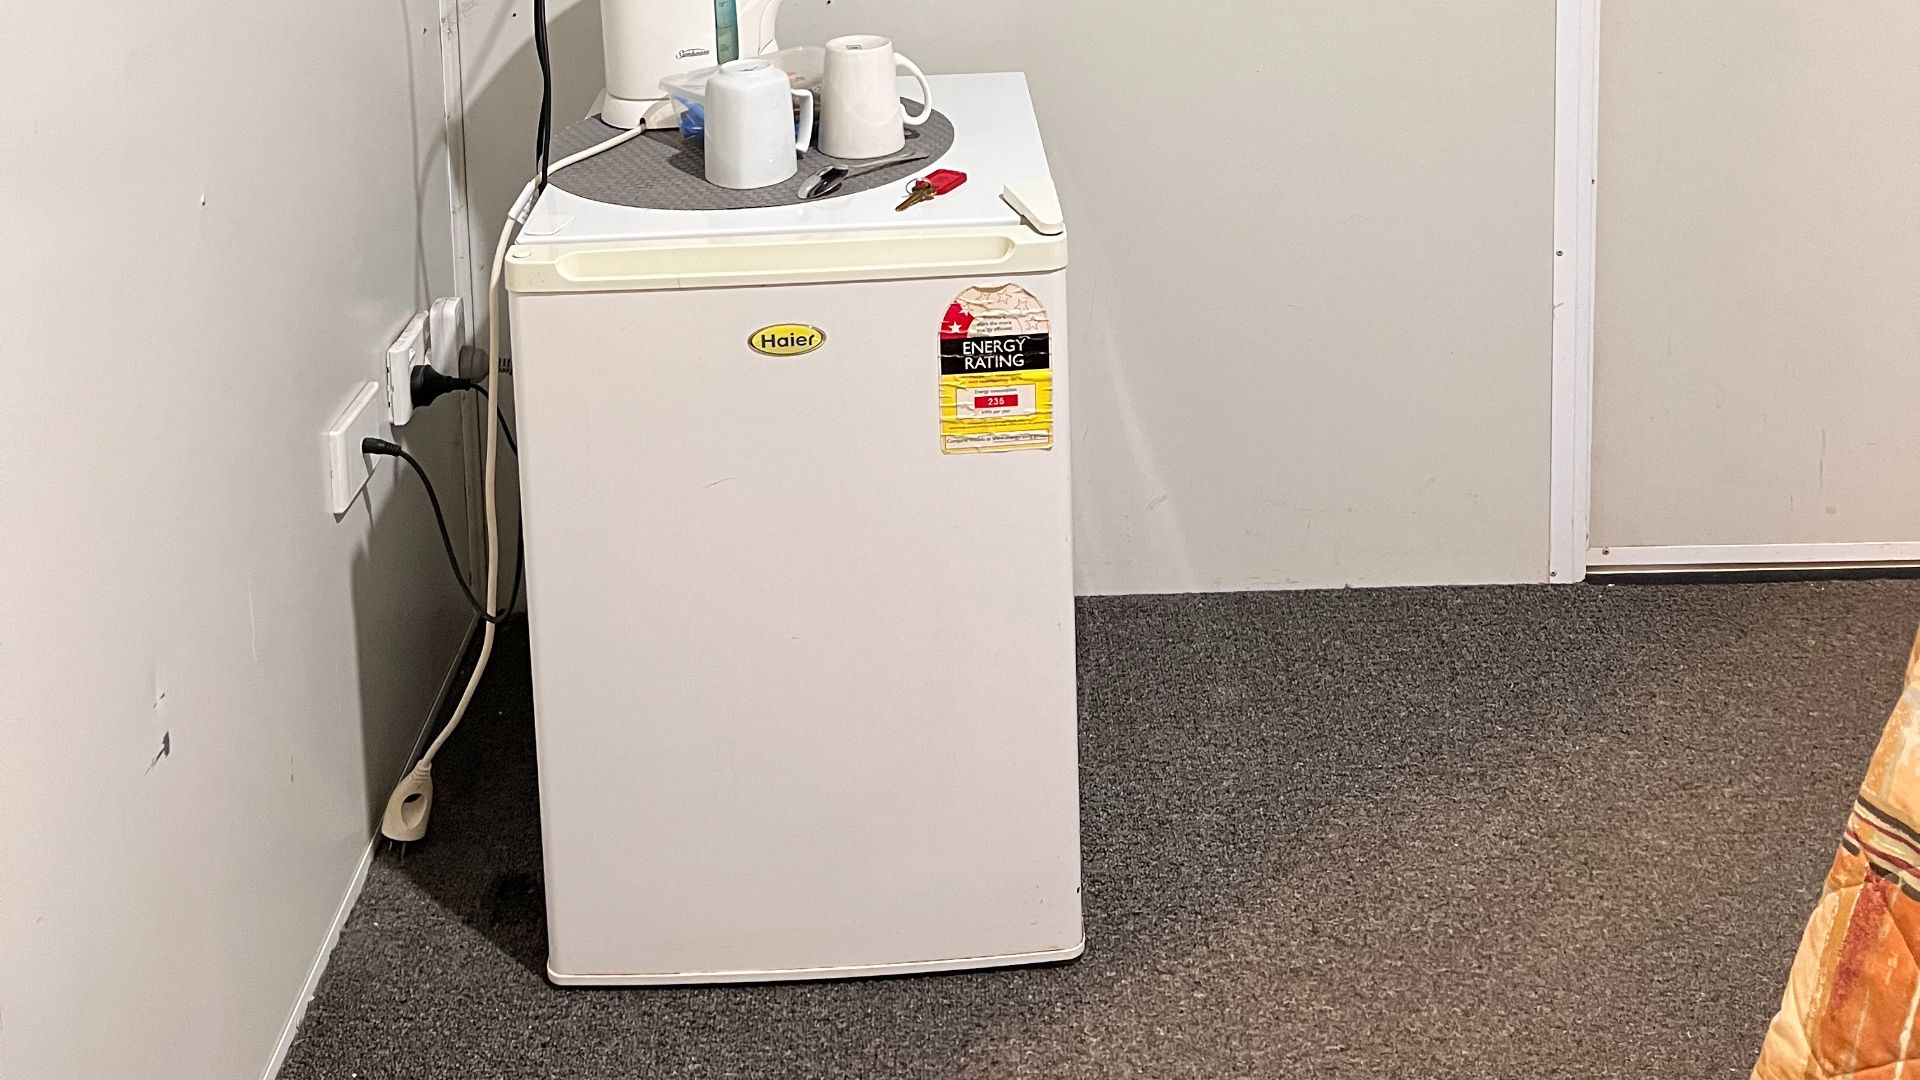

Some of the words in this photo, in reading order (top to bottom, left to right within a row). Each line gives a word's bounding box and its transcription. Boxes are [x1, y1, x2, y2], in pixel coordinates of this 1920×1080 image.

[761, 332, 815, 348] Haier
[962, 338, 1026, 355] ENERGY
[964, 353, 1025, 370] RATING
